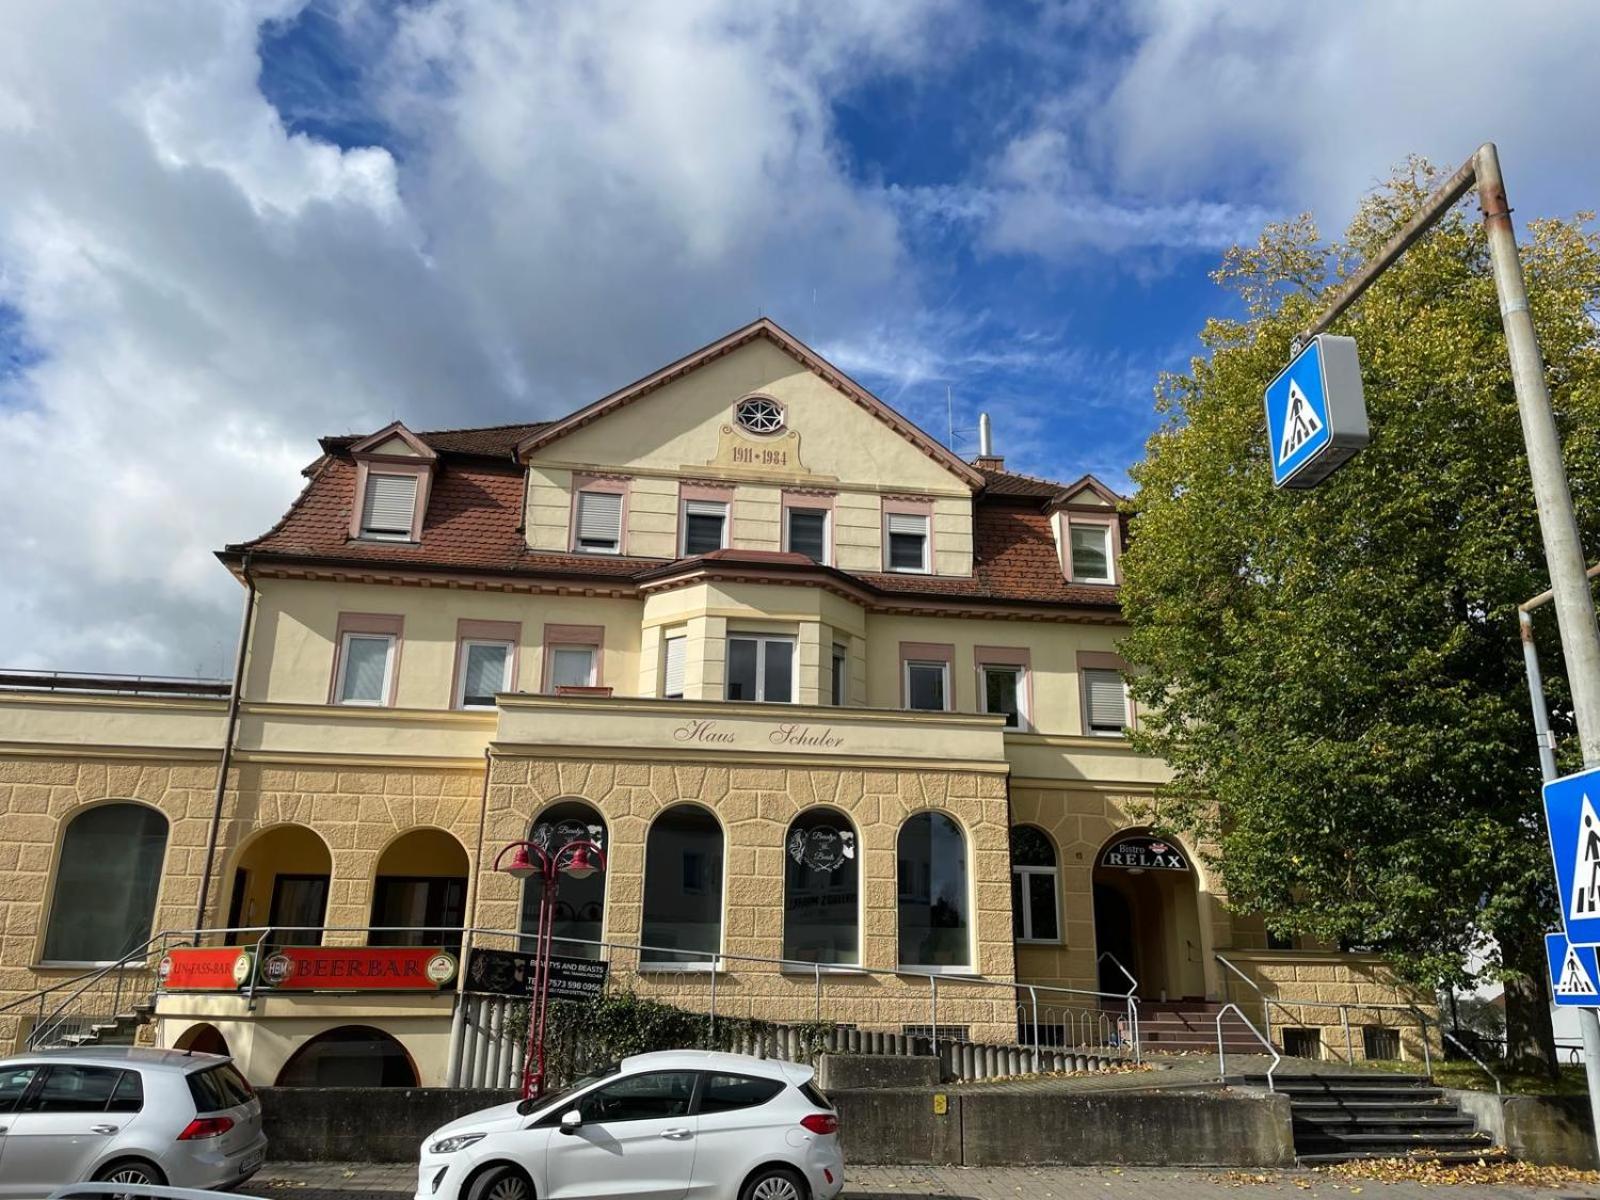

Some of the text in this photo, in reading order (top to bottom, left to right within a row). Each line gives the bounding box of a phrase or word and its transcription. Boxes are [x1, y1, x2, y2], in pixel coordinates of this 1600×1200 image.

[733, 446, 753, 463] 1911
[673, 719, 845, 748] Haus Schuler
[1119, 844, 1146, 854] Bistro
[1110, 853, 1181, 868] RELAX
[298, 959, 422, 977] BEERBAR
[561, 962, 578, 971] AND
[578, 964, 604, 974] BEASTS
